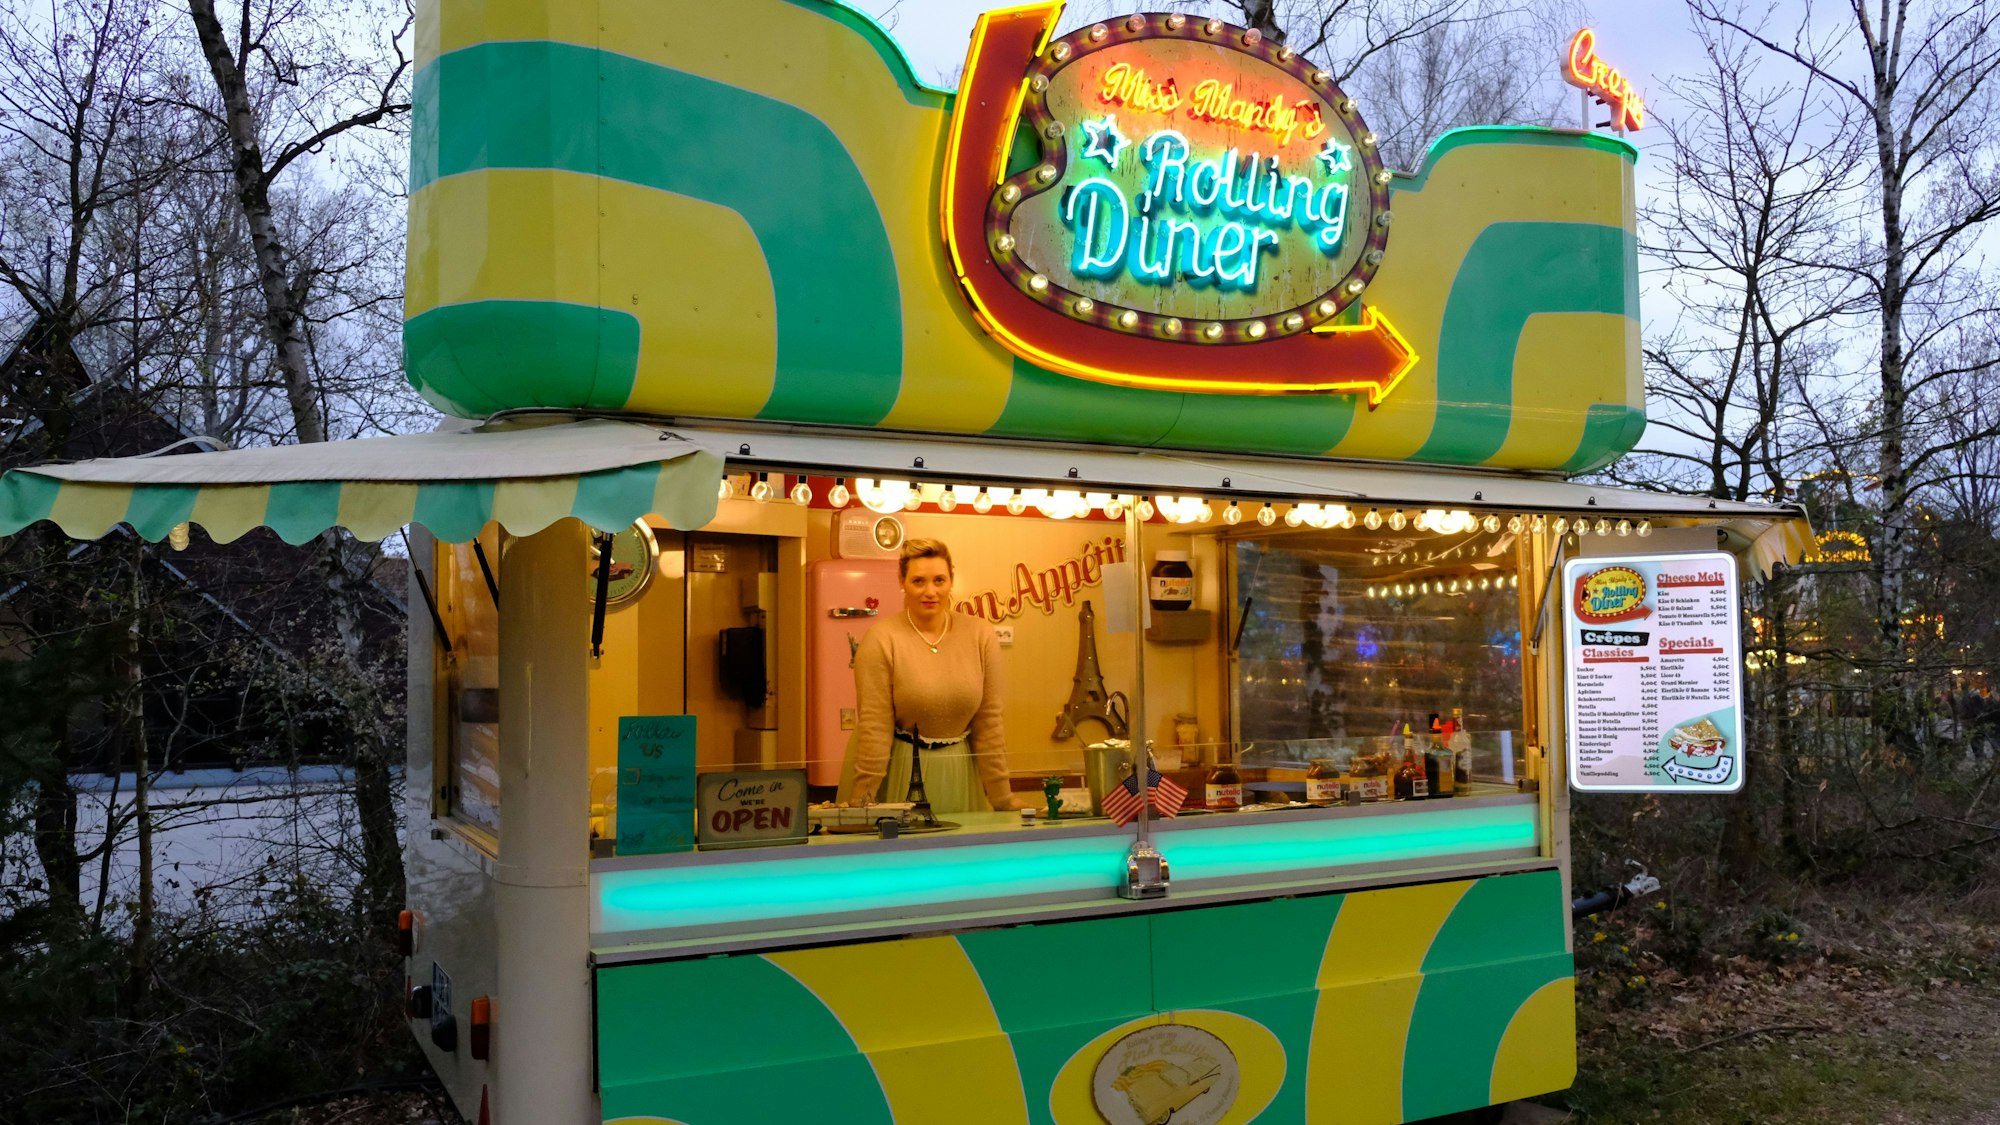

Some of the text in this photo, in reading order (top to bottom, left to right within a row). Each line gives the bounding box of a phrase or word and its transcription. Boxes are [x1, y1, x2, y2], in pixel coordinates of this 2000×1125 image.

[1101, 62, 1325, 147] Miss Mandy's
[1142, 130, 1349, 247] Rolling
[1063, 177, 1279, 287] Diner
[1656, 572, 1724, 582] Cheese Melt
[1602, 586, 1638, 598] Rolling
[955, 591, 1004, 620] on
[1591, 596, 1626, 611] Diner
[1584, 631, 1640, 645] Crêpes
[1659, 637, 1714, 649] Specials
[1582, 648, 1634, 657] Classics
[718, 778, 784, 801] Come in
[711, 806, 791, 833] OPEN
